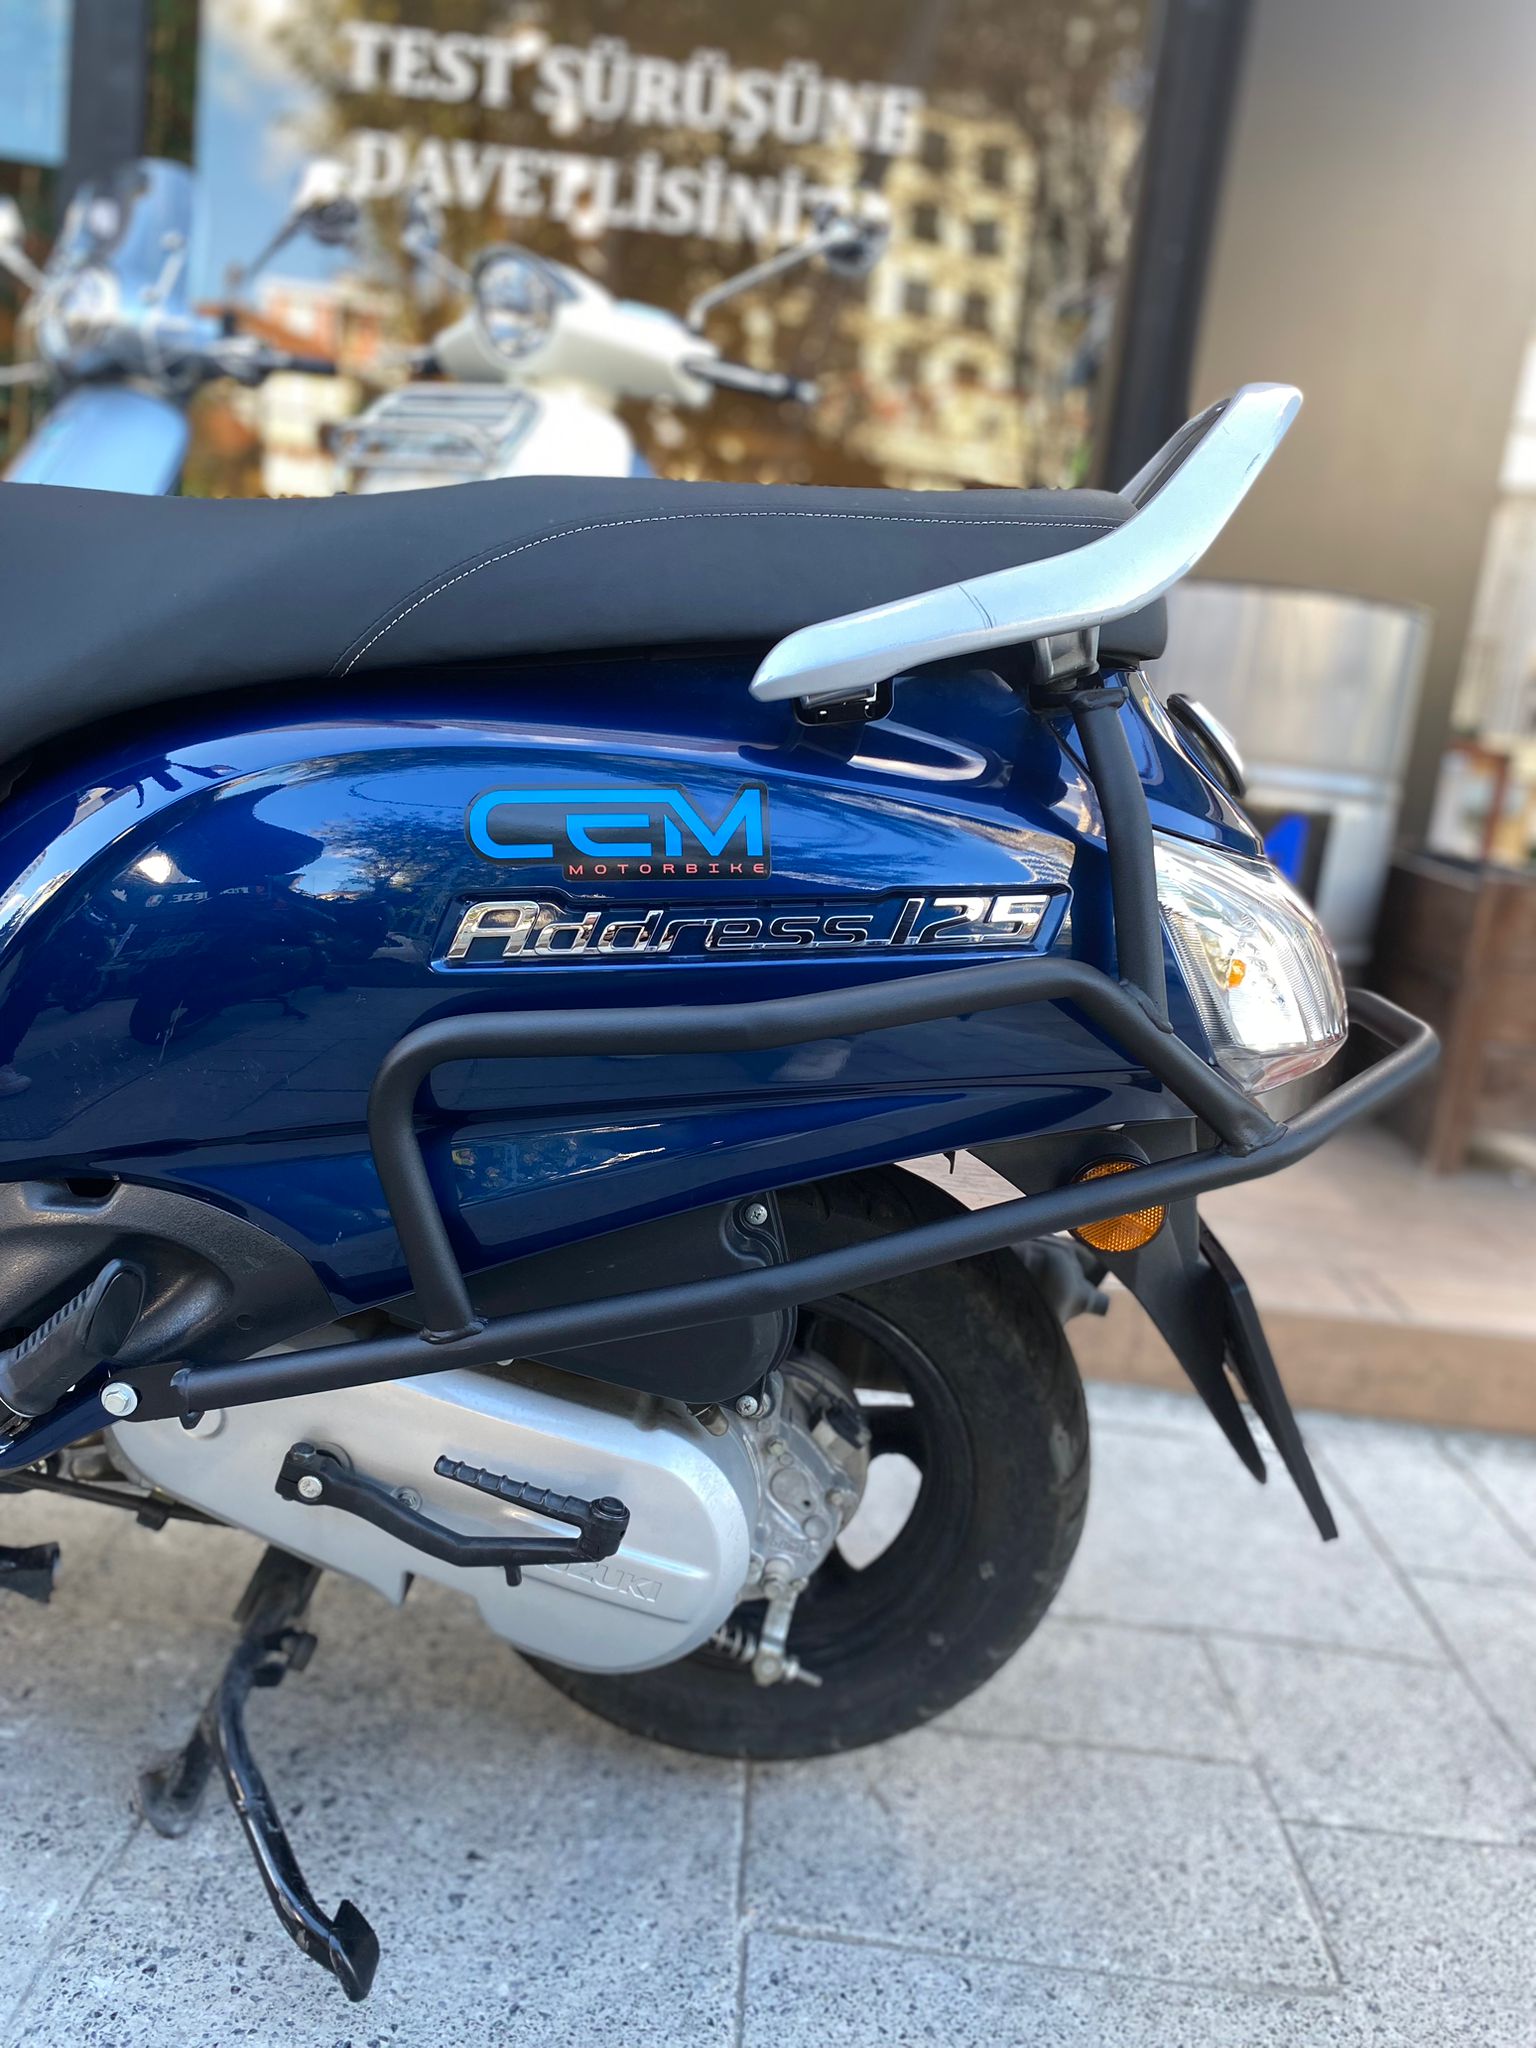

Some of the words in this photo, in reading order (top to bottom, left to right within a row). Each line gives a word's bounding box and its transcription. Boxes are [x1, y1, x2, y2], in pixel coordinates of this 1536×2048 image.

[343, 21, 516, 107] TEST
[471, 788, 764, 858] CEM
[568, 863, 766, 875] MOTORBIKE
[446, 900, 874, 960] Address
[887, 893, 1051, 946] 125
[543, 1561, 662, 1603] ZUKI
